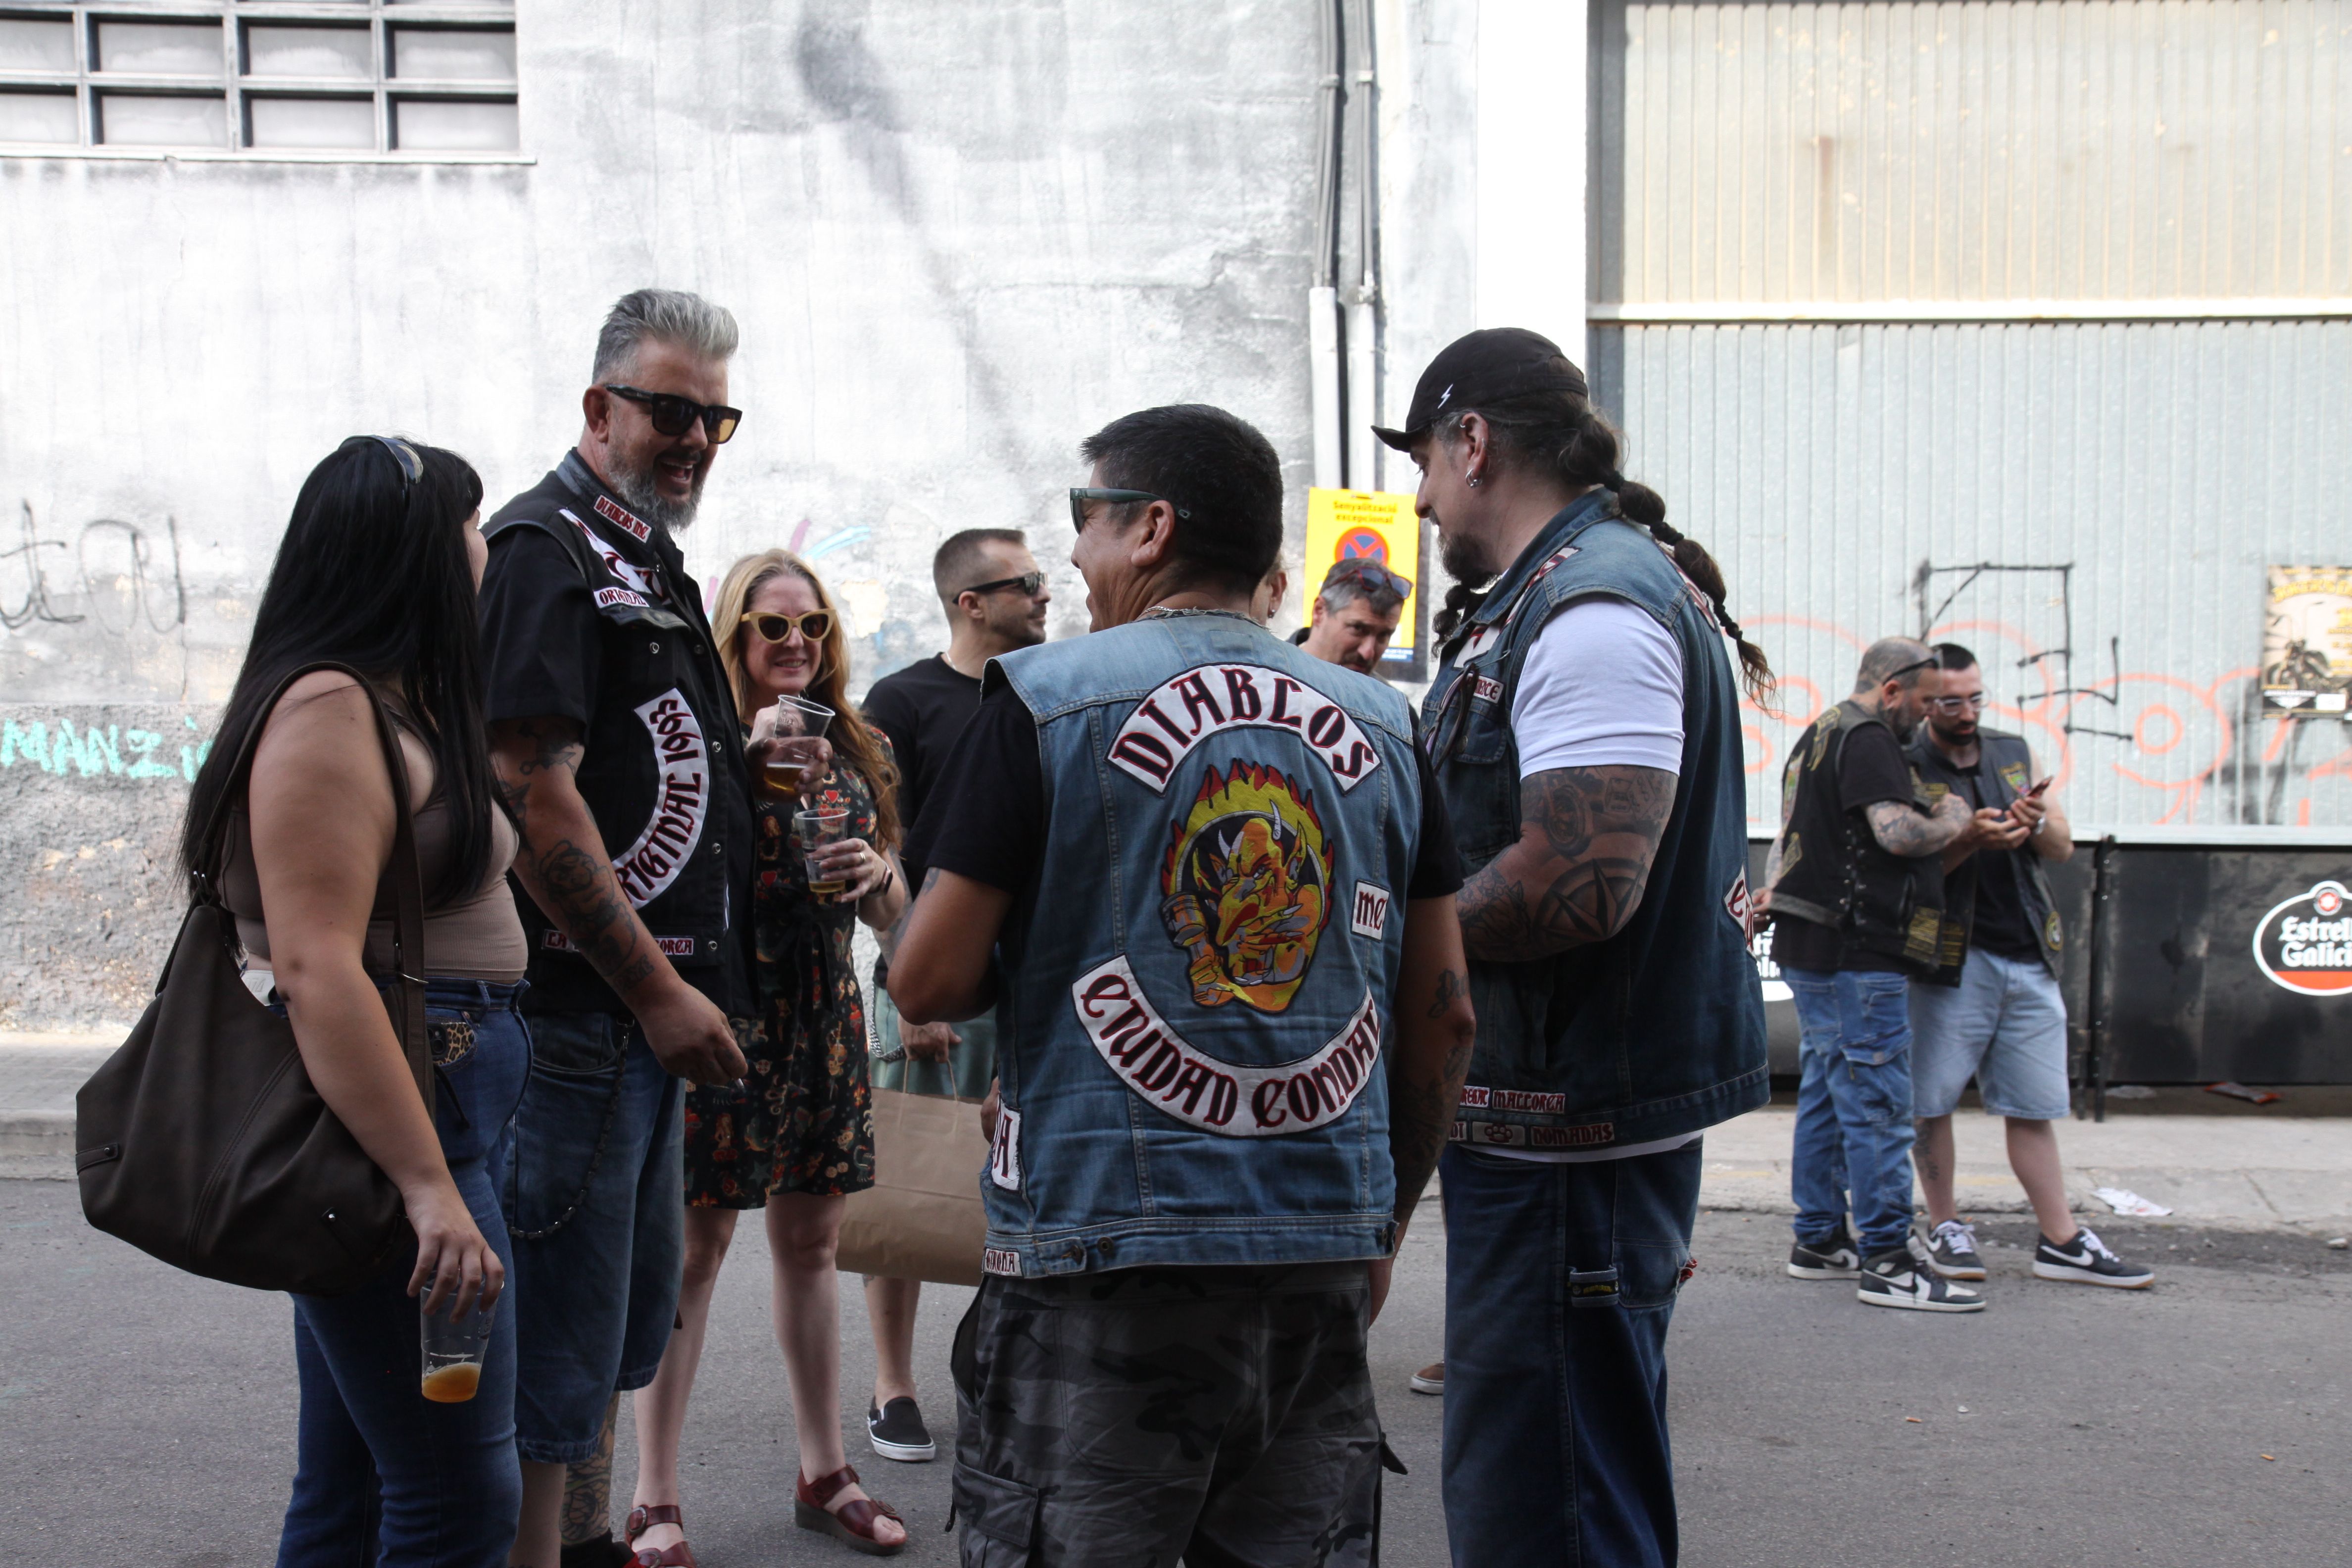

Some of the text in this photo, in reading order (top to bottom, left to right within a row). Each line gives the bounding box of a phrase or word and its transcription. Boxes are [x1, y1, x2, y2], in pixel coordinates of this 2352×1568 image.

[599, 589, 646, 605] ORIGINAL
[1111, 667, 1374, 783] DIABLOS
[616, 773, 701, 904] RIGINAL
[2278, 916, 2352, 942] Estrel
[1080, 973, 1382, 1128] CIUDAD CONDAL
[1494, 1090, 1564, 1112] MALLORCA
[1533, 1124, 1614, 1146] NOMADAS
[986, 1250, 1015, 1274] GIRONA
